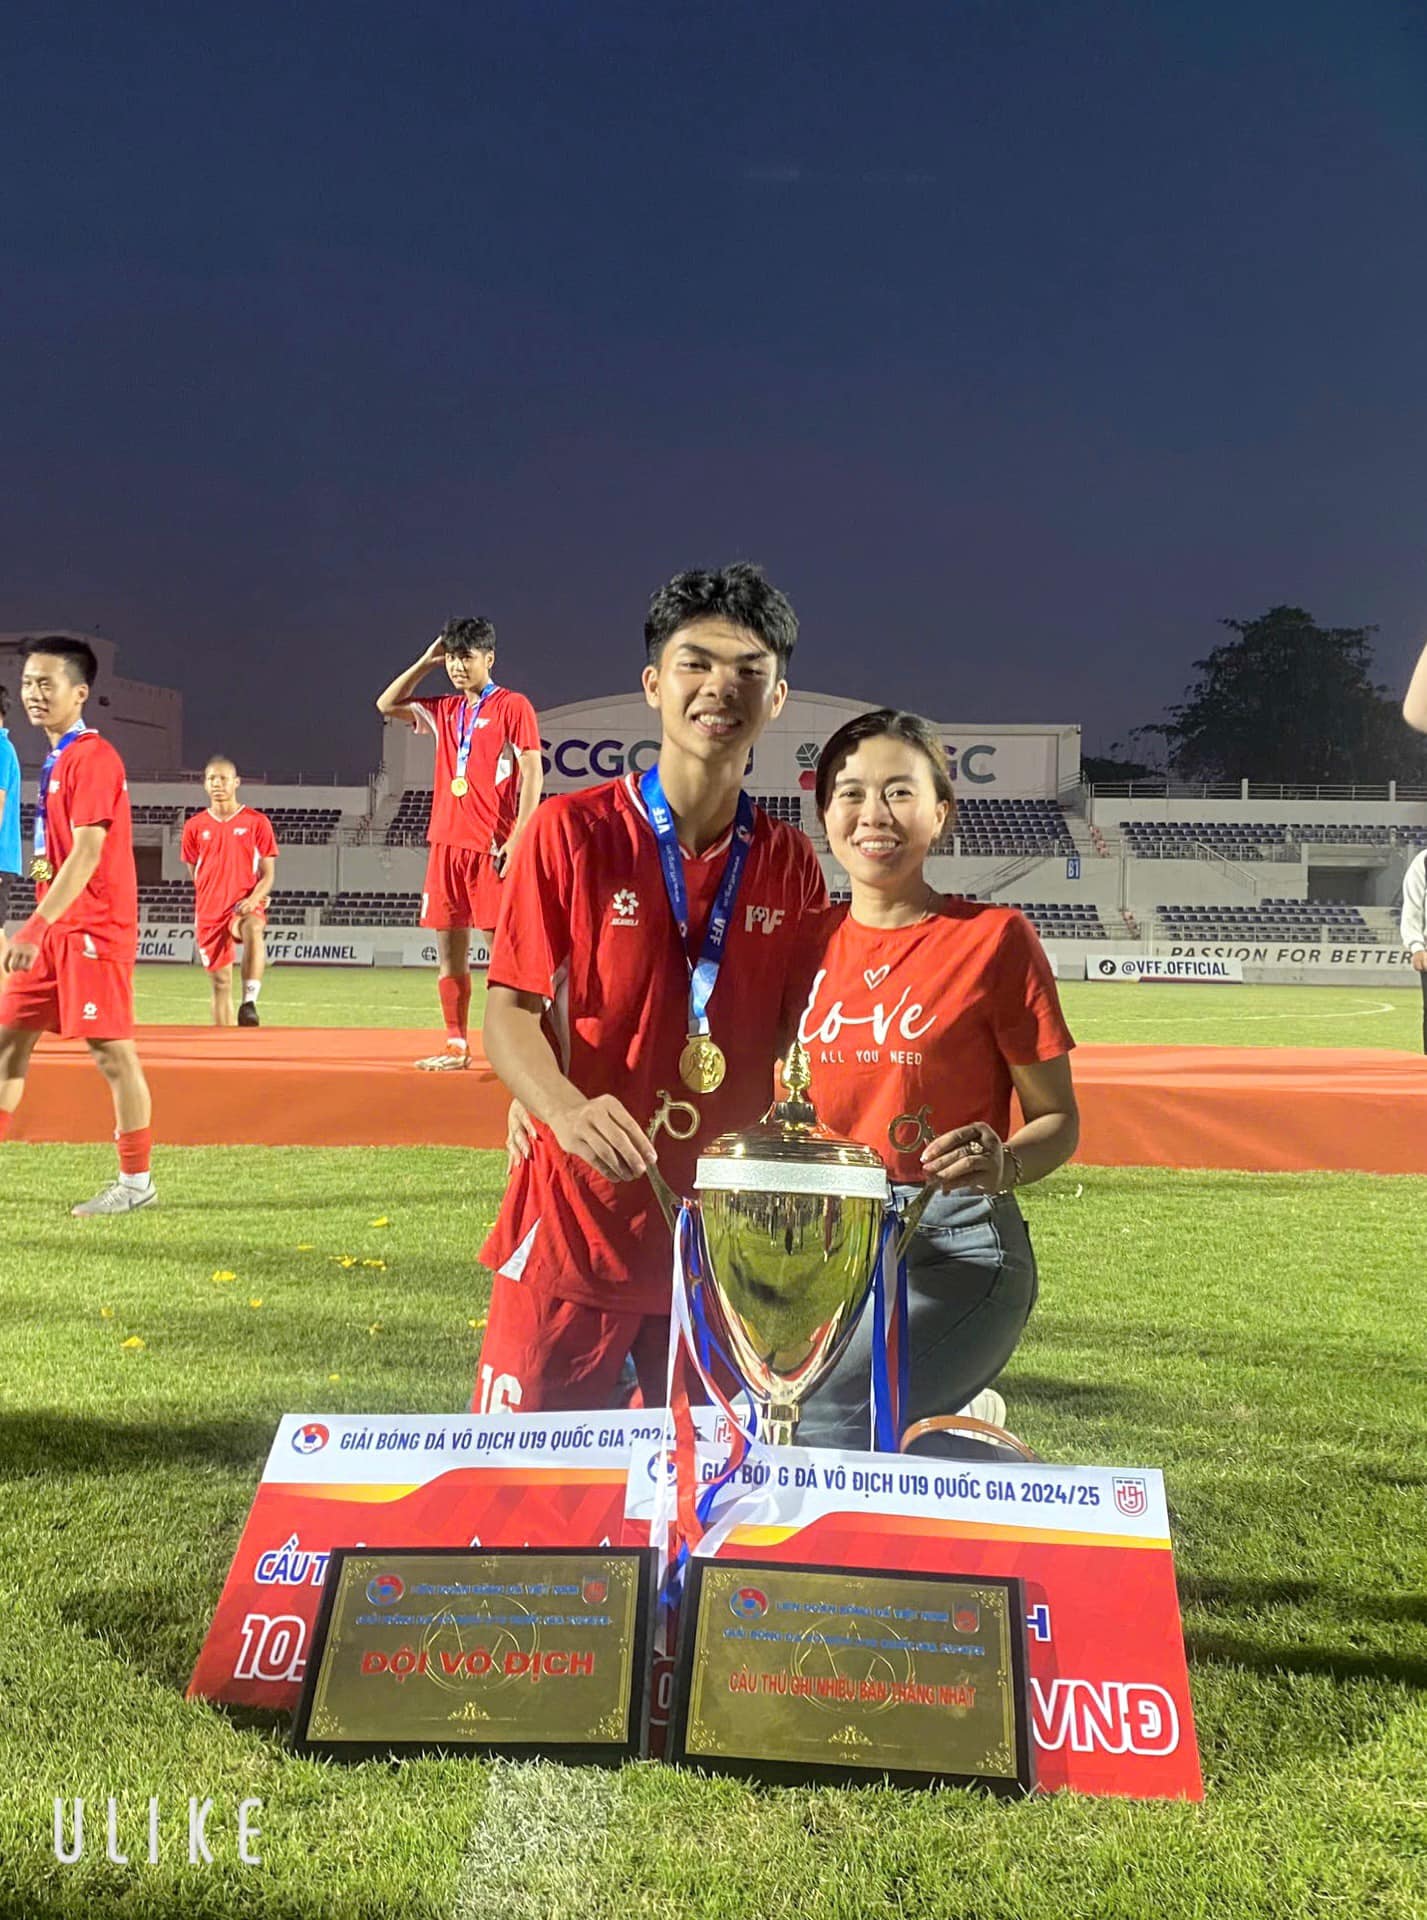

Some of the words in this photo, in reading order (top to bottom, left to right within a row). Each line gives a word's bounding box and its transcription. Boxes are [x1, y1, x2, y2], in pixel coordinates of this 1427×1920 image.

[652, 807, 670, 834] VFF
[710, 917, 726, 946] VFF
[266, 945, 291, 958] VFF
[294, 945, 358, 960] CHANNEL
[1276, 948, 1322, 963] FOR
[1121, 960, 1230, 977] @VFF.OFFICIAL
[820, 1050, 845, 1063] ALL
[855, 1050, 879, 1063] YOU
[889, 1050, 923, 1065] NEED
[375, 1427, 421, 1450] BÓNG
[519, 1430, 547, 1450] U19
[550, 1424, 594, 1451] QUỐC
[599, 1428, 625, 1448] GIA
[794, 1463, 818, 1489] ĐÁ
[823, 1465, 847, 1491] VÔ
[852, 1471, 894, 1499] ĐỊCH
[899, 1475, 929, 1496] U19
[933, 1472, 982, 1501] QUỐC
[986, 1480, 1016, 1501] GIA
[1020, 1482, 1101, 1507] 2024/25
[361, 1645, 428, 1683] ĐỘI
[439, 1645, 492, 1676] VÔ
[503, 1650, 596, 1684] ĐỊCH
[1029, 1677, 1181, 1757] VNĐ
